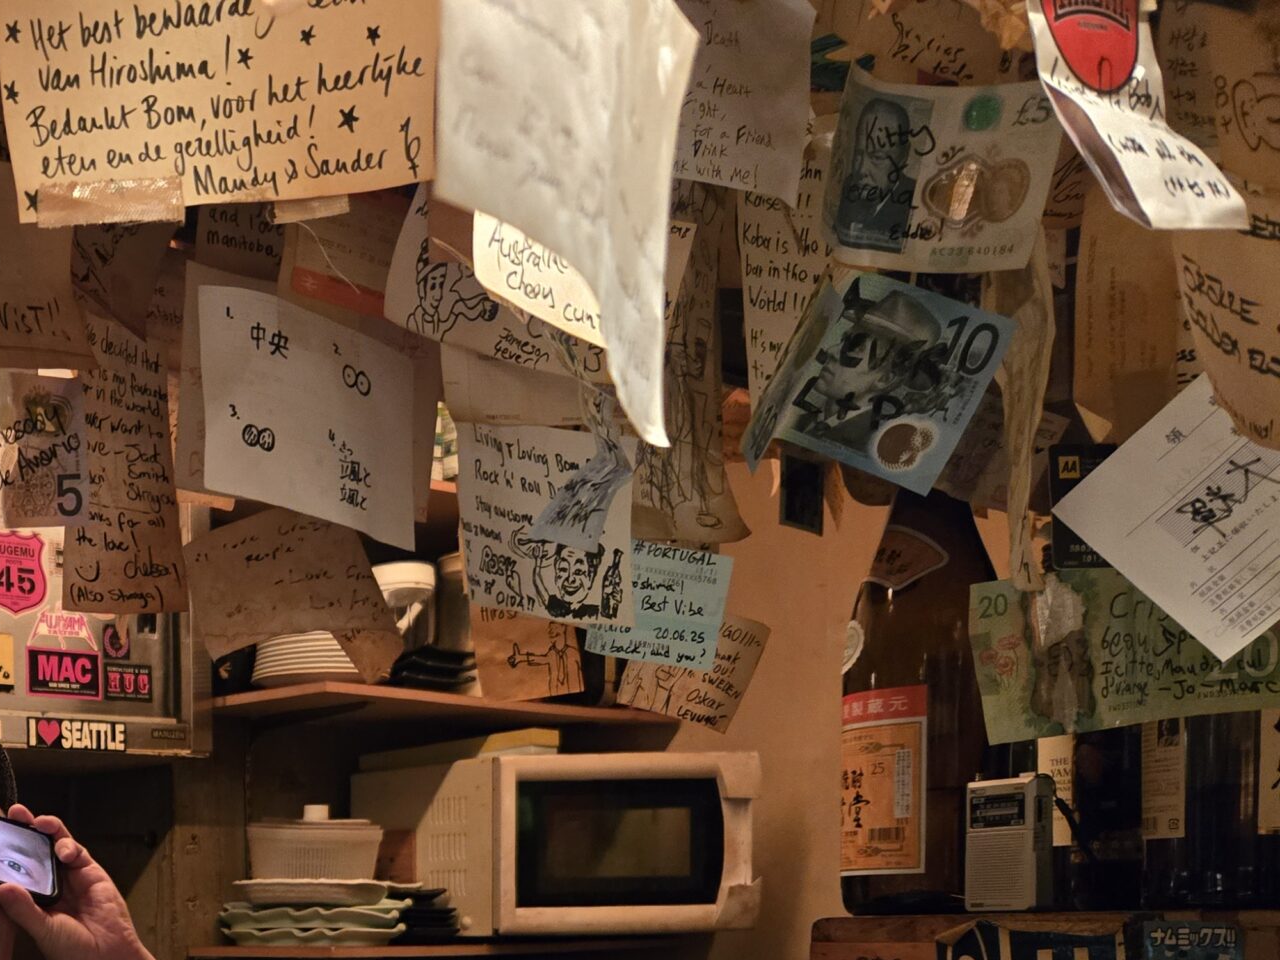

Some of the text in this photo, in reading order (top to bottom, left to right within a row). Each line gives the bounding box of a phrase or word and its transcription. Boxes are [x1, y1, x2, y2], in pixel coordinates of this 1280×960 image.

[30, 14, 71, 60] Het
[80, 14, 123, 49] best
[26, 105, 136, 147] Bedankt
[210, 87, 258, 119] voor
[267, 74, 309, 105] het
[41, 148, 97, 178] eten
[193, 163, 279, 197] Mandy
[305, 138, 388, 179] Sander
[250, 322, 290, 359] 中央
[945, 315, 1000, 376] 10
[56, 474, 83, 517] 5
[641, 595, 704, 617] Best Vibe
[980, 593, 1008, 619] 20
[37, 655, 92, 684] MAC
[107, 672, 149, 695] HUG
[29, 718, 126, 751] I SEATTLE
[871, 762, 886, 775] 25
